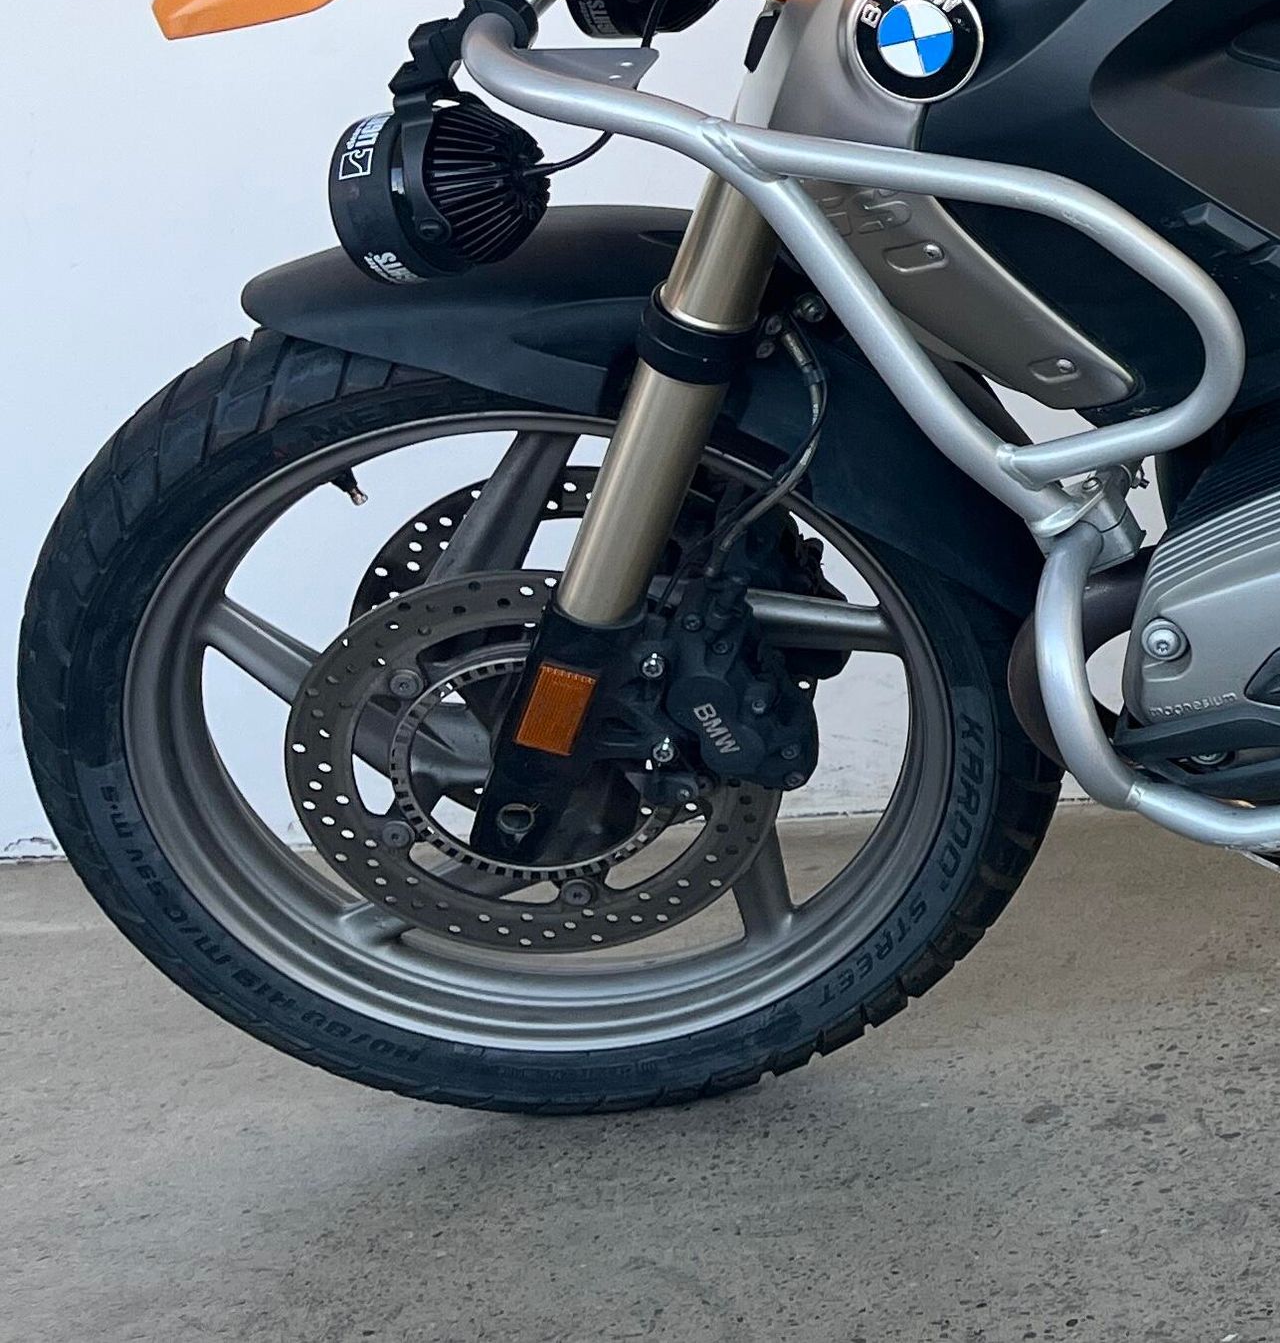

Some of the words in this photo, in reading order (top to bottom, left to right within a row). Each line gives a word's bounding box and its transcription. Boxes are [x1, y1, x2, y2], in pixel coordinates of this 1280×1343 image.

[693, 703, 741, 754] BMW
[1149, 692, 1238, 716] magnesium
[818, 899, 929, 1008] STREET
